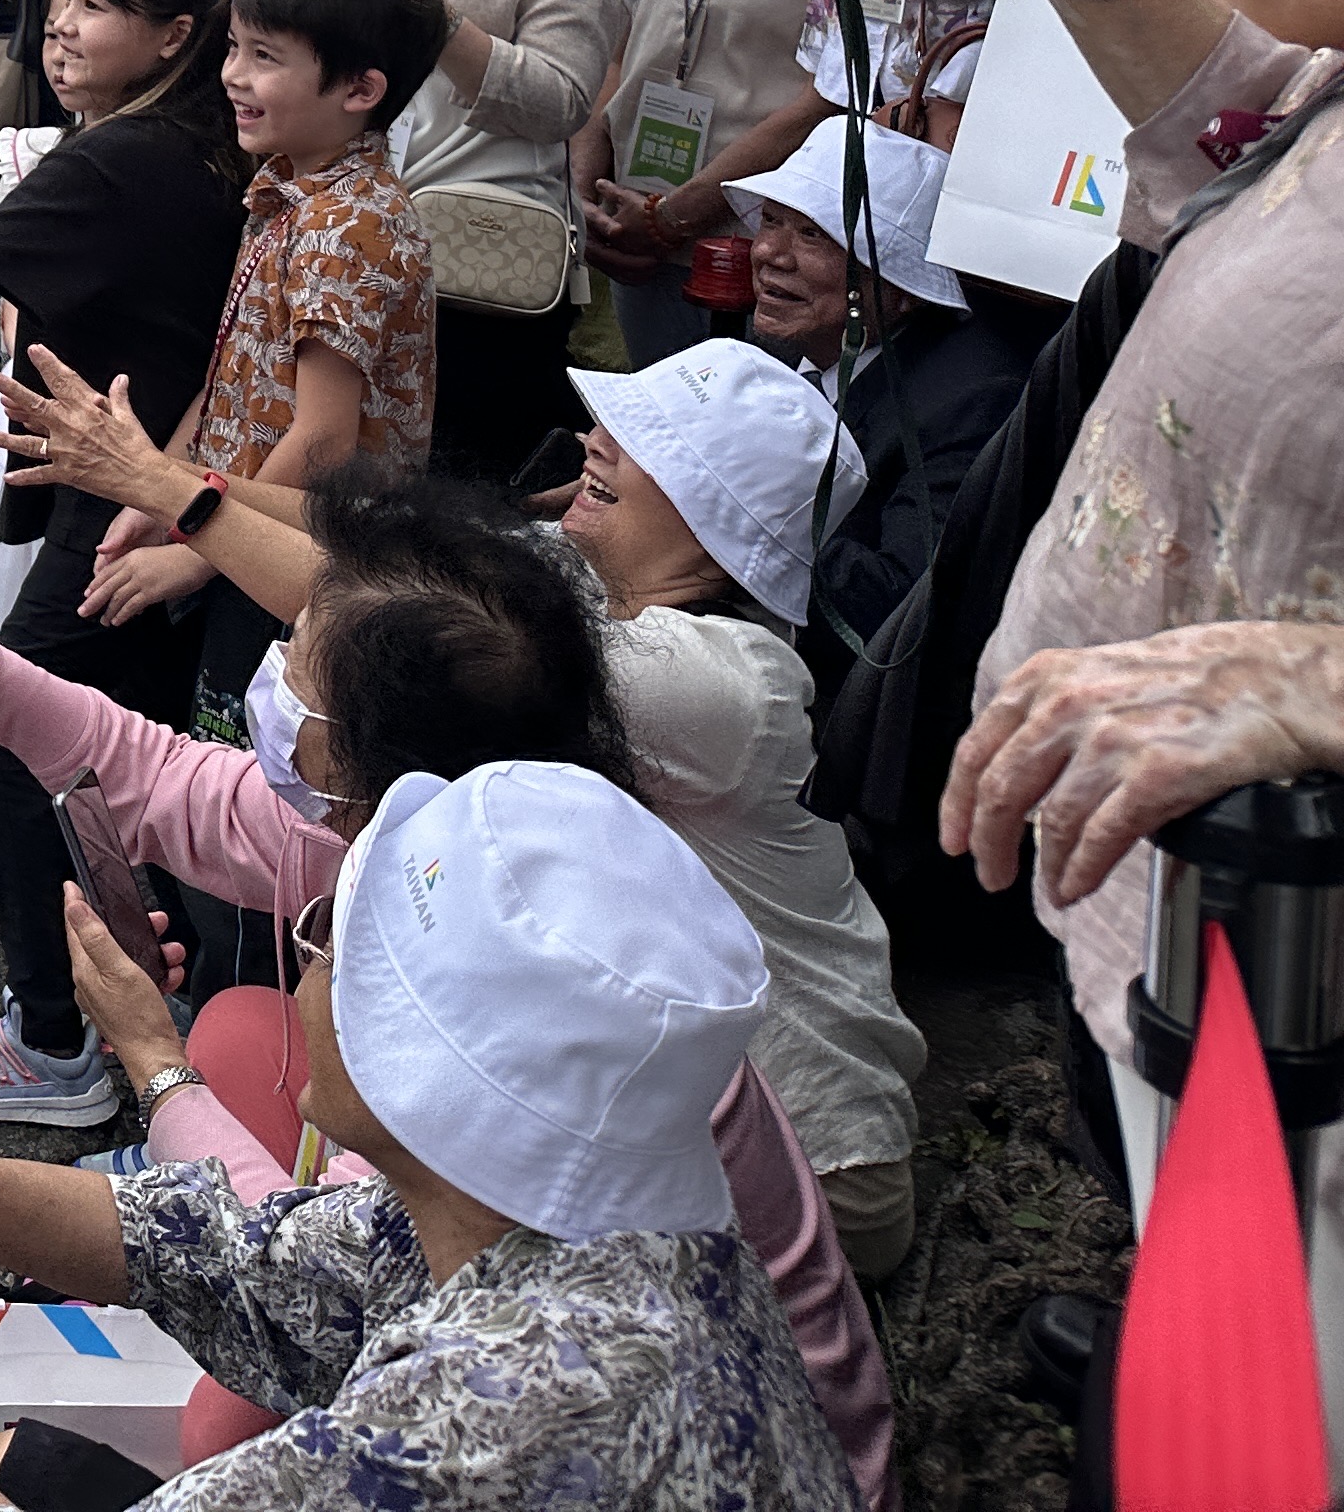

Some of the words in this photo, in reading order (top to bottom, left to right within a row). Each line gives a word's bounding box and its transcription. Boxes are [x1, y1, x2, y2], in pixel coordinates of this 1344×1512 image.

[1104, 159, 1123, 174] TH
[675, 365, 711, 404] TAIWAN
[403, 853, 436, 934] TAIWAN
